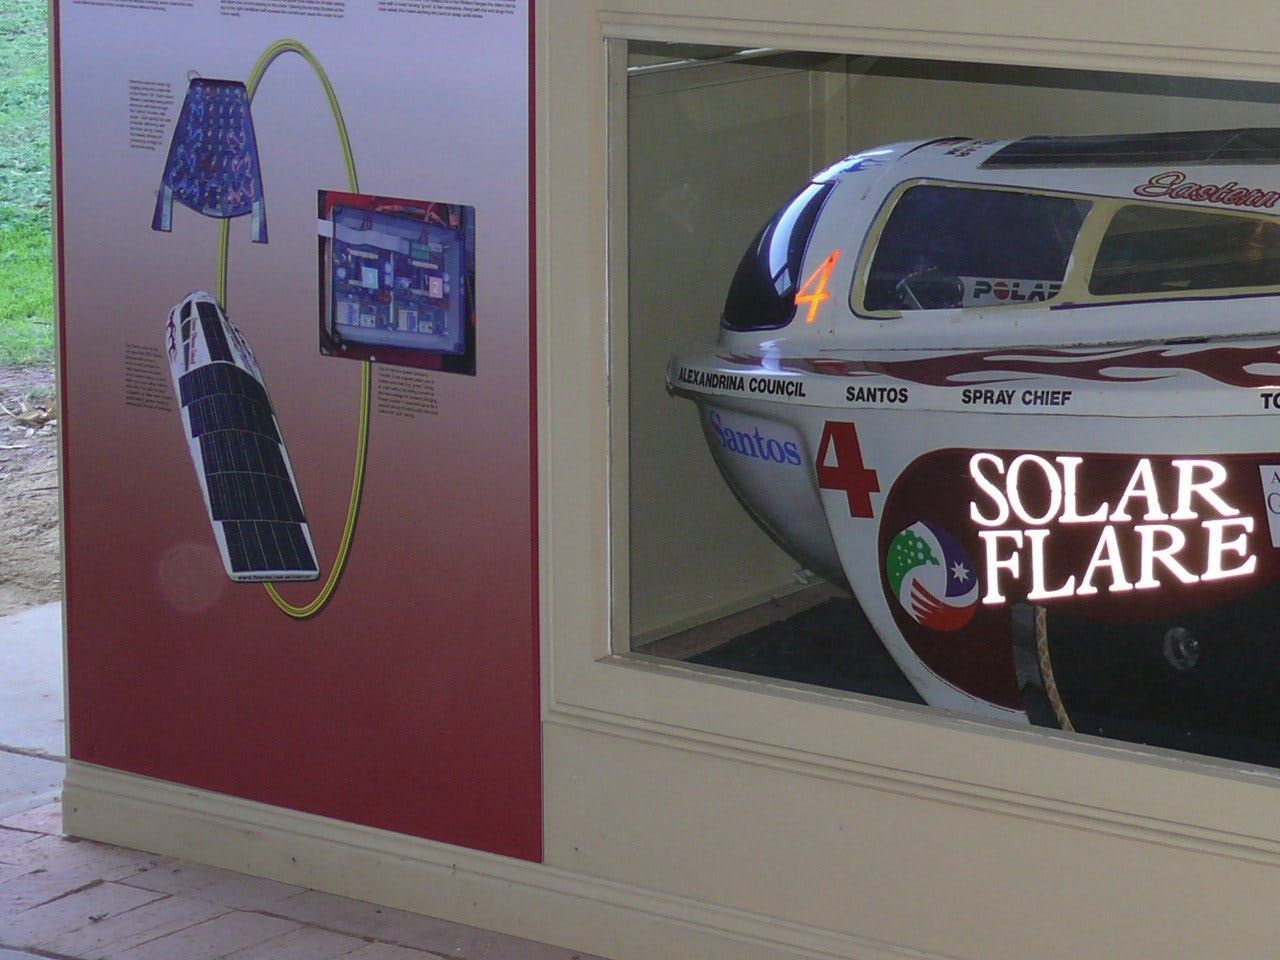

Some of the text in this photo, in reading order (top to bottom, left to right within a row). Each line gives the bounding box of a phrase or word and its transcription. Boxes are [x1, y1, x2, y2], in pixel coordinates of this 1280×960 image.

[795, 248, 842, 324] 4
[678, 368, 806, 397] ALEXANDRINA COUNCIL
[846, 386, 908, 403] SANTOS
[961, 389, 1072, 406] SPRAY CHIEF
[710, 411, 801, 465] Santos
[815, 420, 880, 518] 4
[968, 452, 1240, 526] SOLAR
[982, 516, 1258, 605] FLARE
